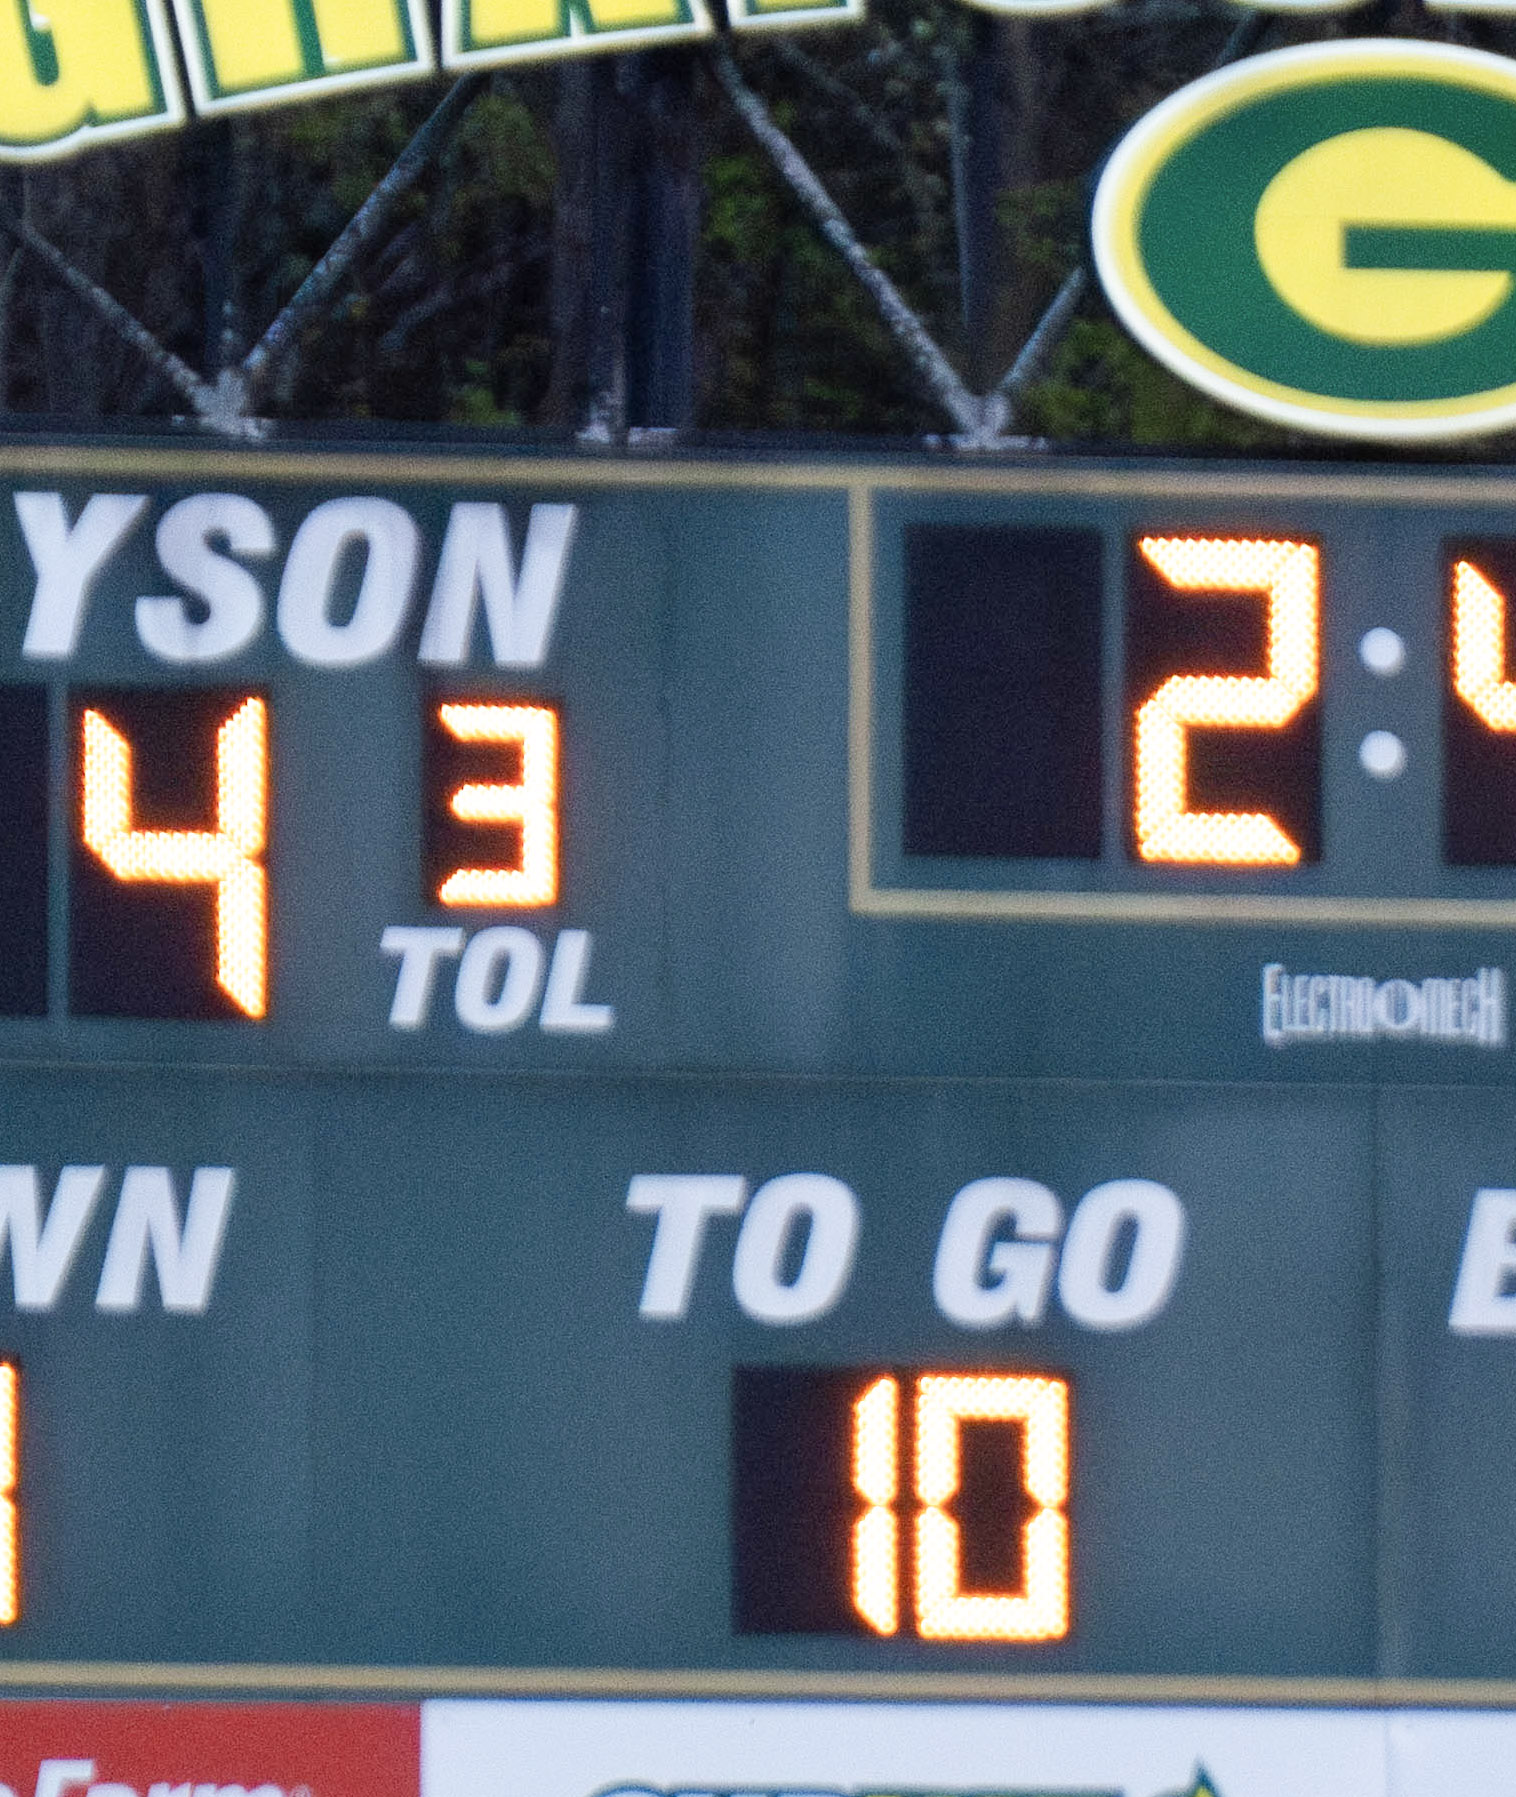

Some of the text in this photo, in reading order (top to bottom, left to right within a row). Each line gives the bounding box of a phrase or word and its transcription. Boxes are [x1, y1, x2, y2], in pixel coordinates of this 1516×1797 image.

[13, 490, 580, 668] YSON
[82, 696, 268, 1020] 4
[438, 703, 560, 908] 3
[380, 925, 615, 1034] TOL
[625, 1173, 1190, 1332] TO GO
[853, 1372, 1070, 1642] 10
